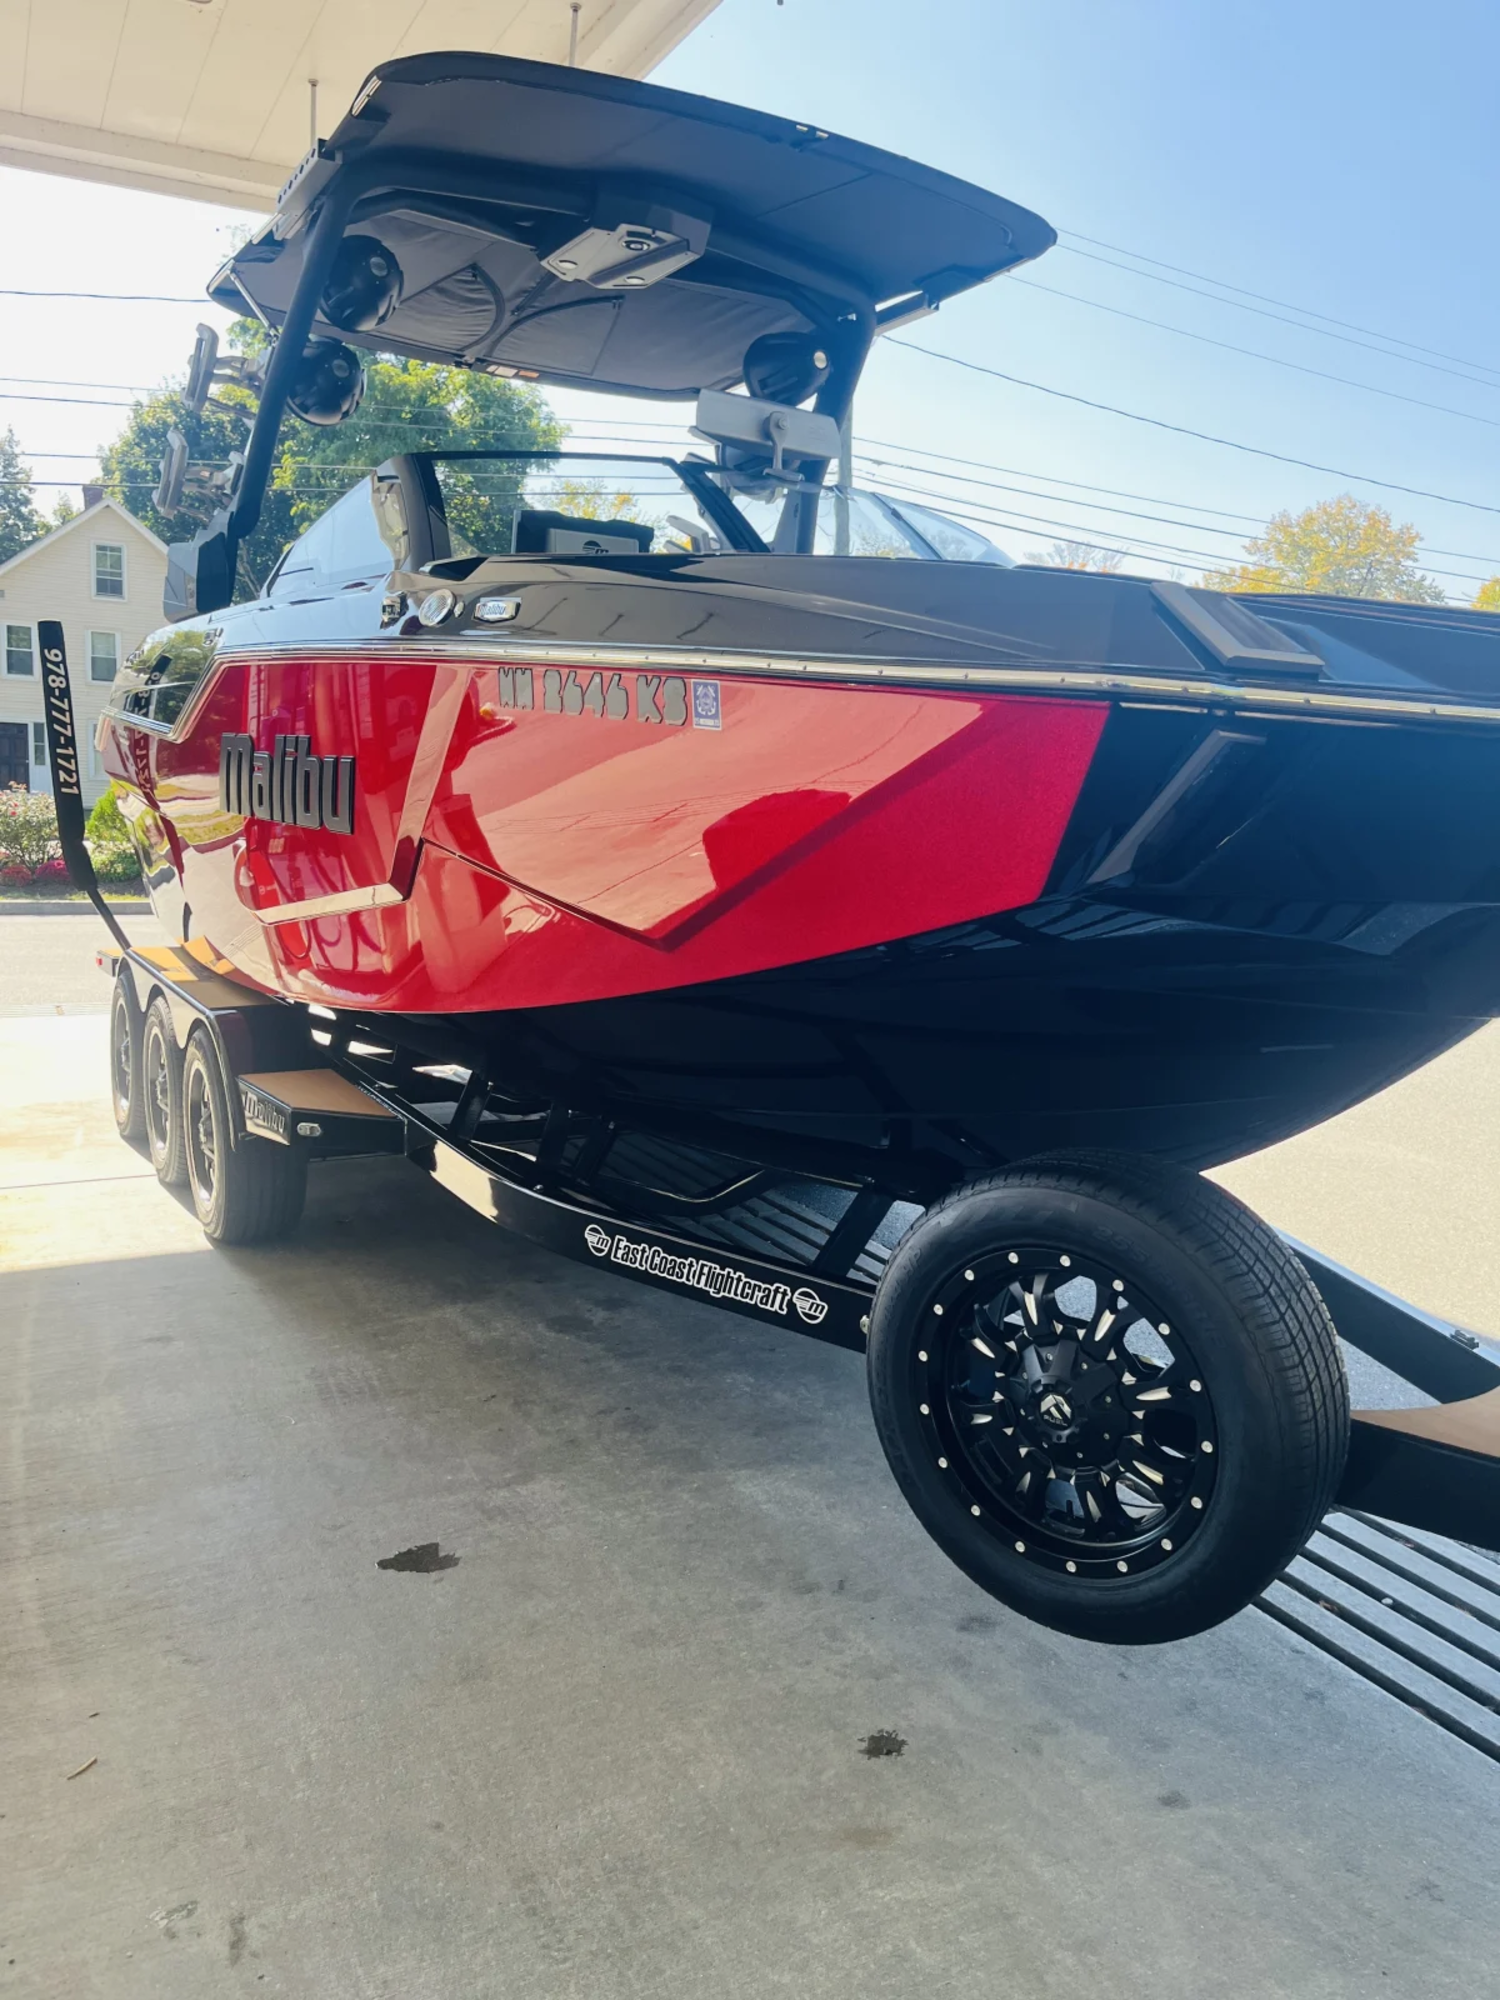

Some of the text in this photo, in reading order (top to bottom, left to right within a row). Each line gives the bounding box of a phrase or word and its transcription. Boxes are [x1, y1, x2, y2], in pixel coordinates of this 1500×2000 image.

[44, 648, 79, 795] 978-777-1721
[219, 732, 356, 835] Malibu
[245, 1091, 285, 1134] Malibu
[610, 1234, 648, 1270] East
[647, 1246, 697, 1285] Coast
[694, 1259, 791, 1315] Flightcraft
